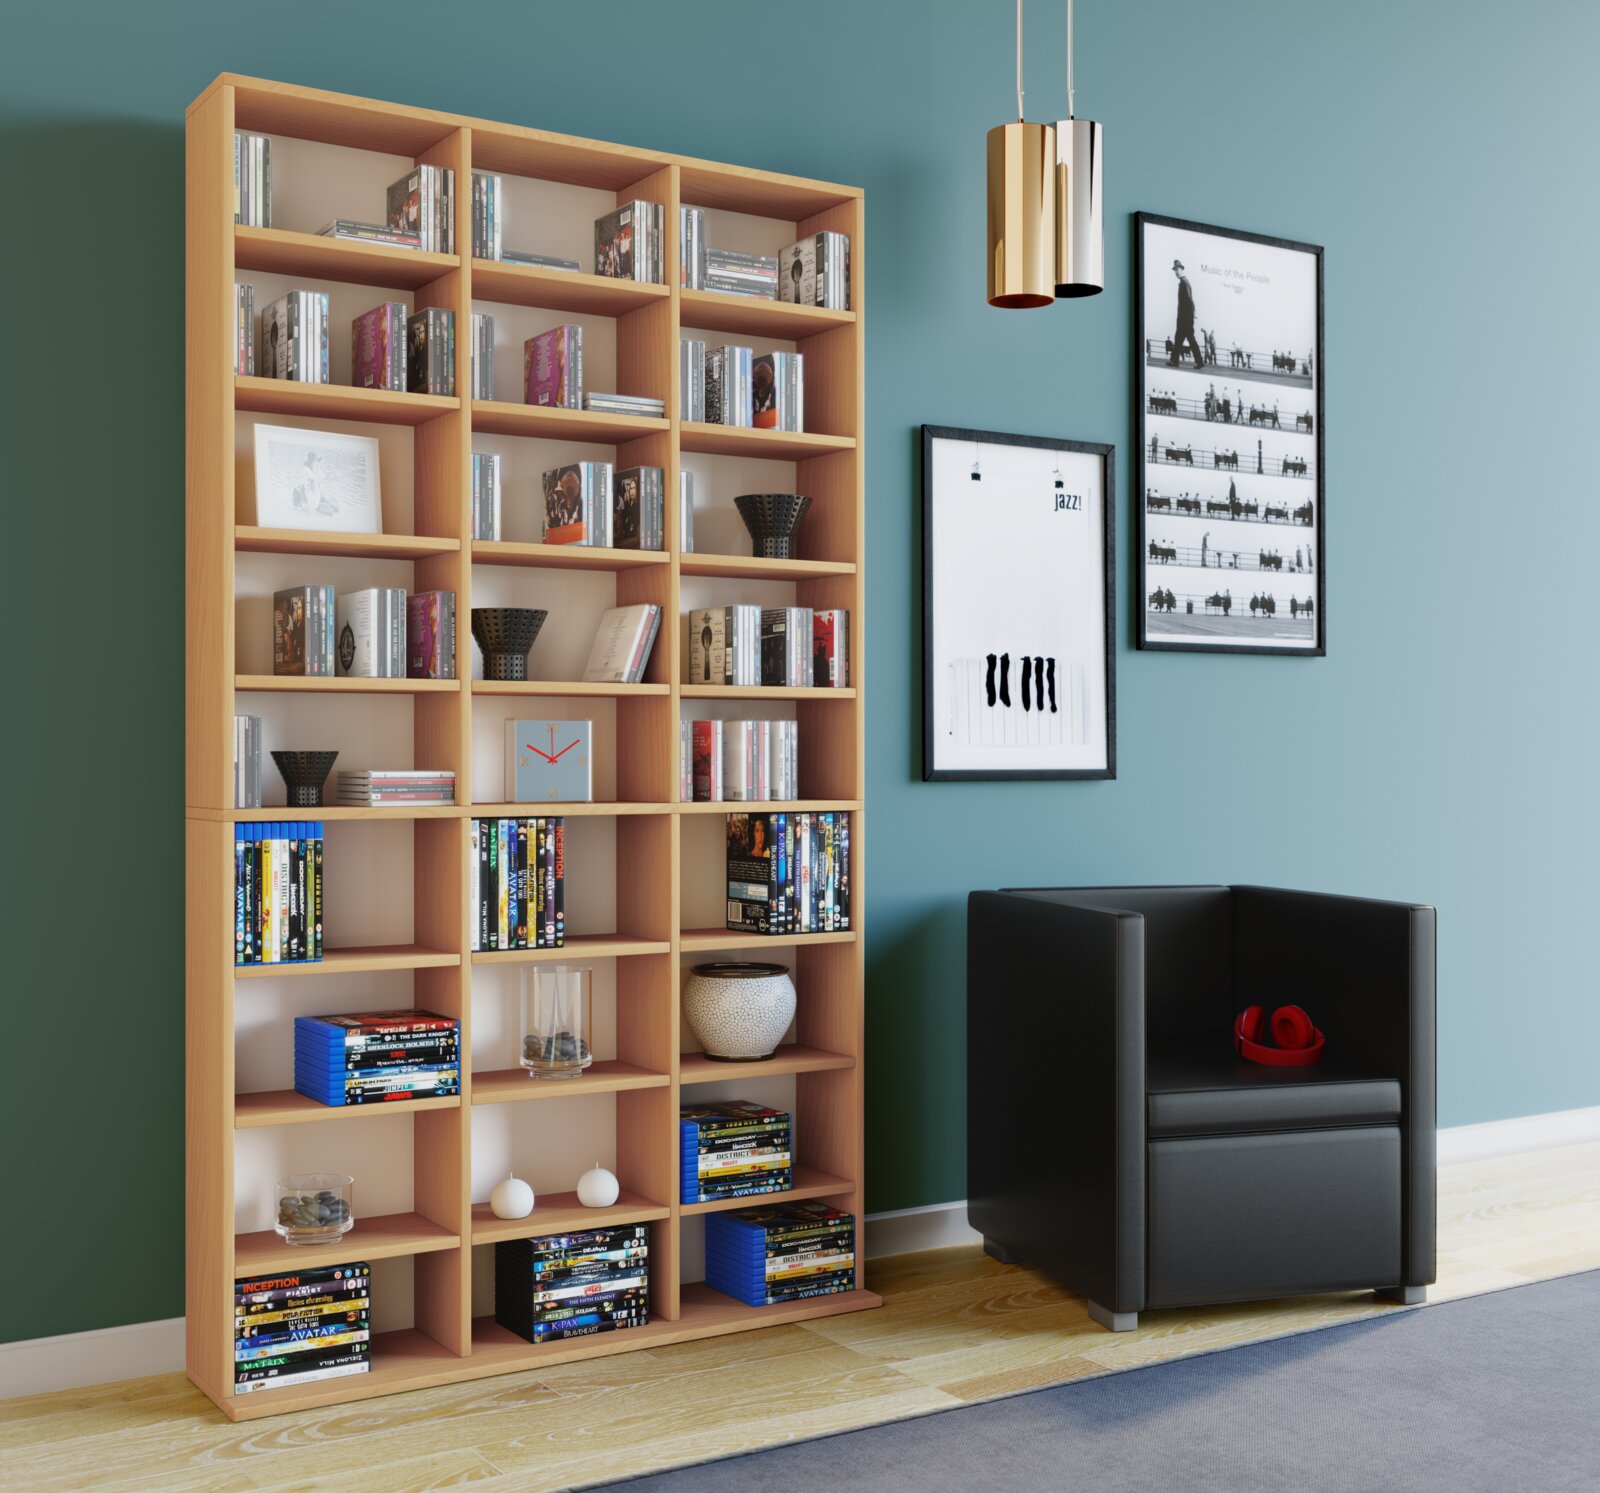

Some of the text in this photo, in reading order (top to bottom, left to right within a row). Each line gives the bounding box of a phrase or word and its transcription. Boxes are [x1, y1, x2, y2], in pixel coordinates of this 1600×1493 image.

[1200, 264, 1271, 284] Music of the People
[1054, 494, 1082, 512] jazz!
[556, 826, 564, 879] INCEPTION
[508, 872, 516, 917] AVATAR
[236, 885, 244, 930] AVATAR
[367, 1040, 434, 1051] SHERLOCK HOLMES
[384, 1092, 413, 1101] JAWS
[715, 1134, 756, 1144] DOOMSDAY
[716, 1152, 748, 1160] DISTRICT
[732, 1186, 767, 1197] AVATAR
[783, 1252, 816, 1264] DISTRICT
[243, 1277, 300, 1293] INCEPTION
[798, 1288, 831, 1298] AVATAR
[300, 1307, 324, 1316] FICTION
[551, 1319, 578, 1330] K-PAX
[290, 1326, 337, 1341] AVATAR
[564, 1326, 598, 1338] BRAVEHEART
[244, 1357, 285, 1370] MATRIX
